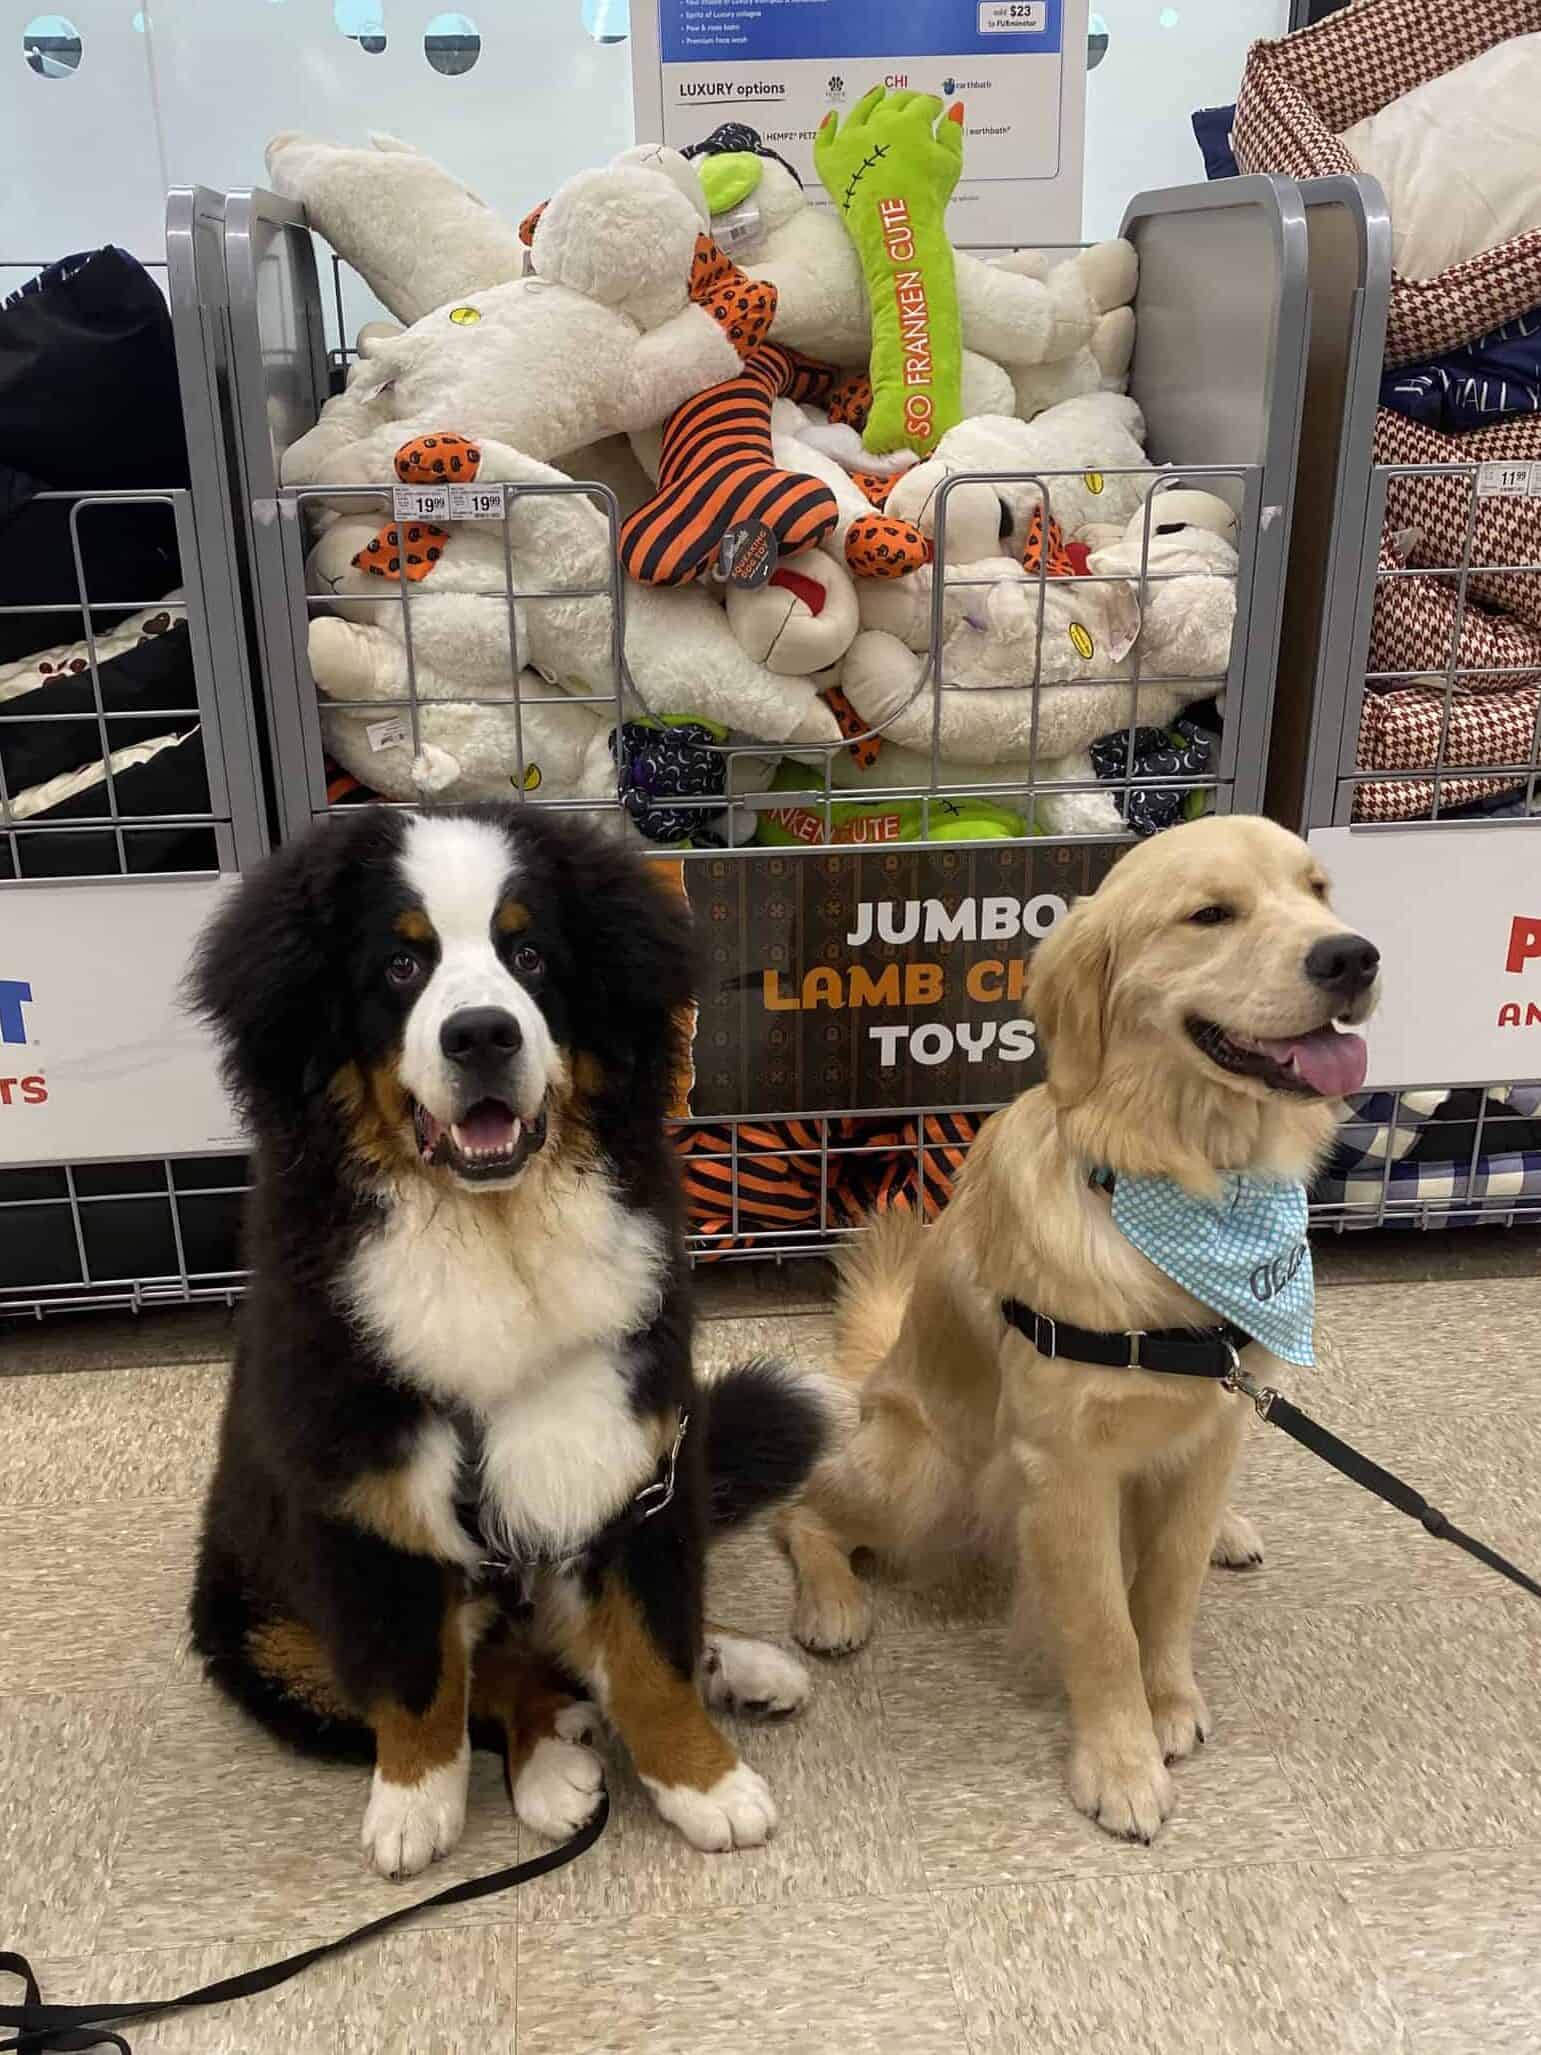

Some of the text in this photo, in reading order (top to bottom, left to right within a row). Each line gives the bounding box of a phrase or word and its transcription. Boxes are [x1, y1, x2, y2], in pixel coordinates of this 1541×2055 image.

[1010, 5, 1031, 17] $23
[680, 81, 785, 98] LUXURY options
[885, 75, 908, 88] CHI
[881, 199, 932, 437] SO FRANKEN CUTE
[847, 894, 1069, 946] JUMBO
[763, 963, 945, 1011] LAMB
[869, 1019, 1036, 1067] TOYS
